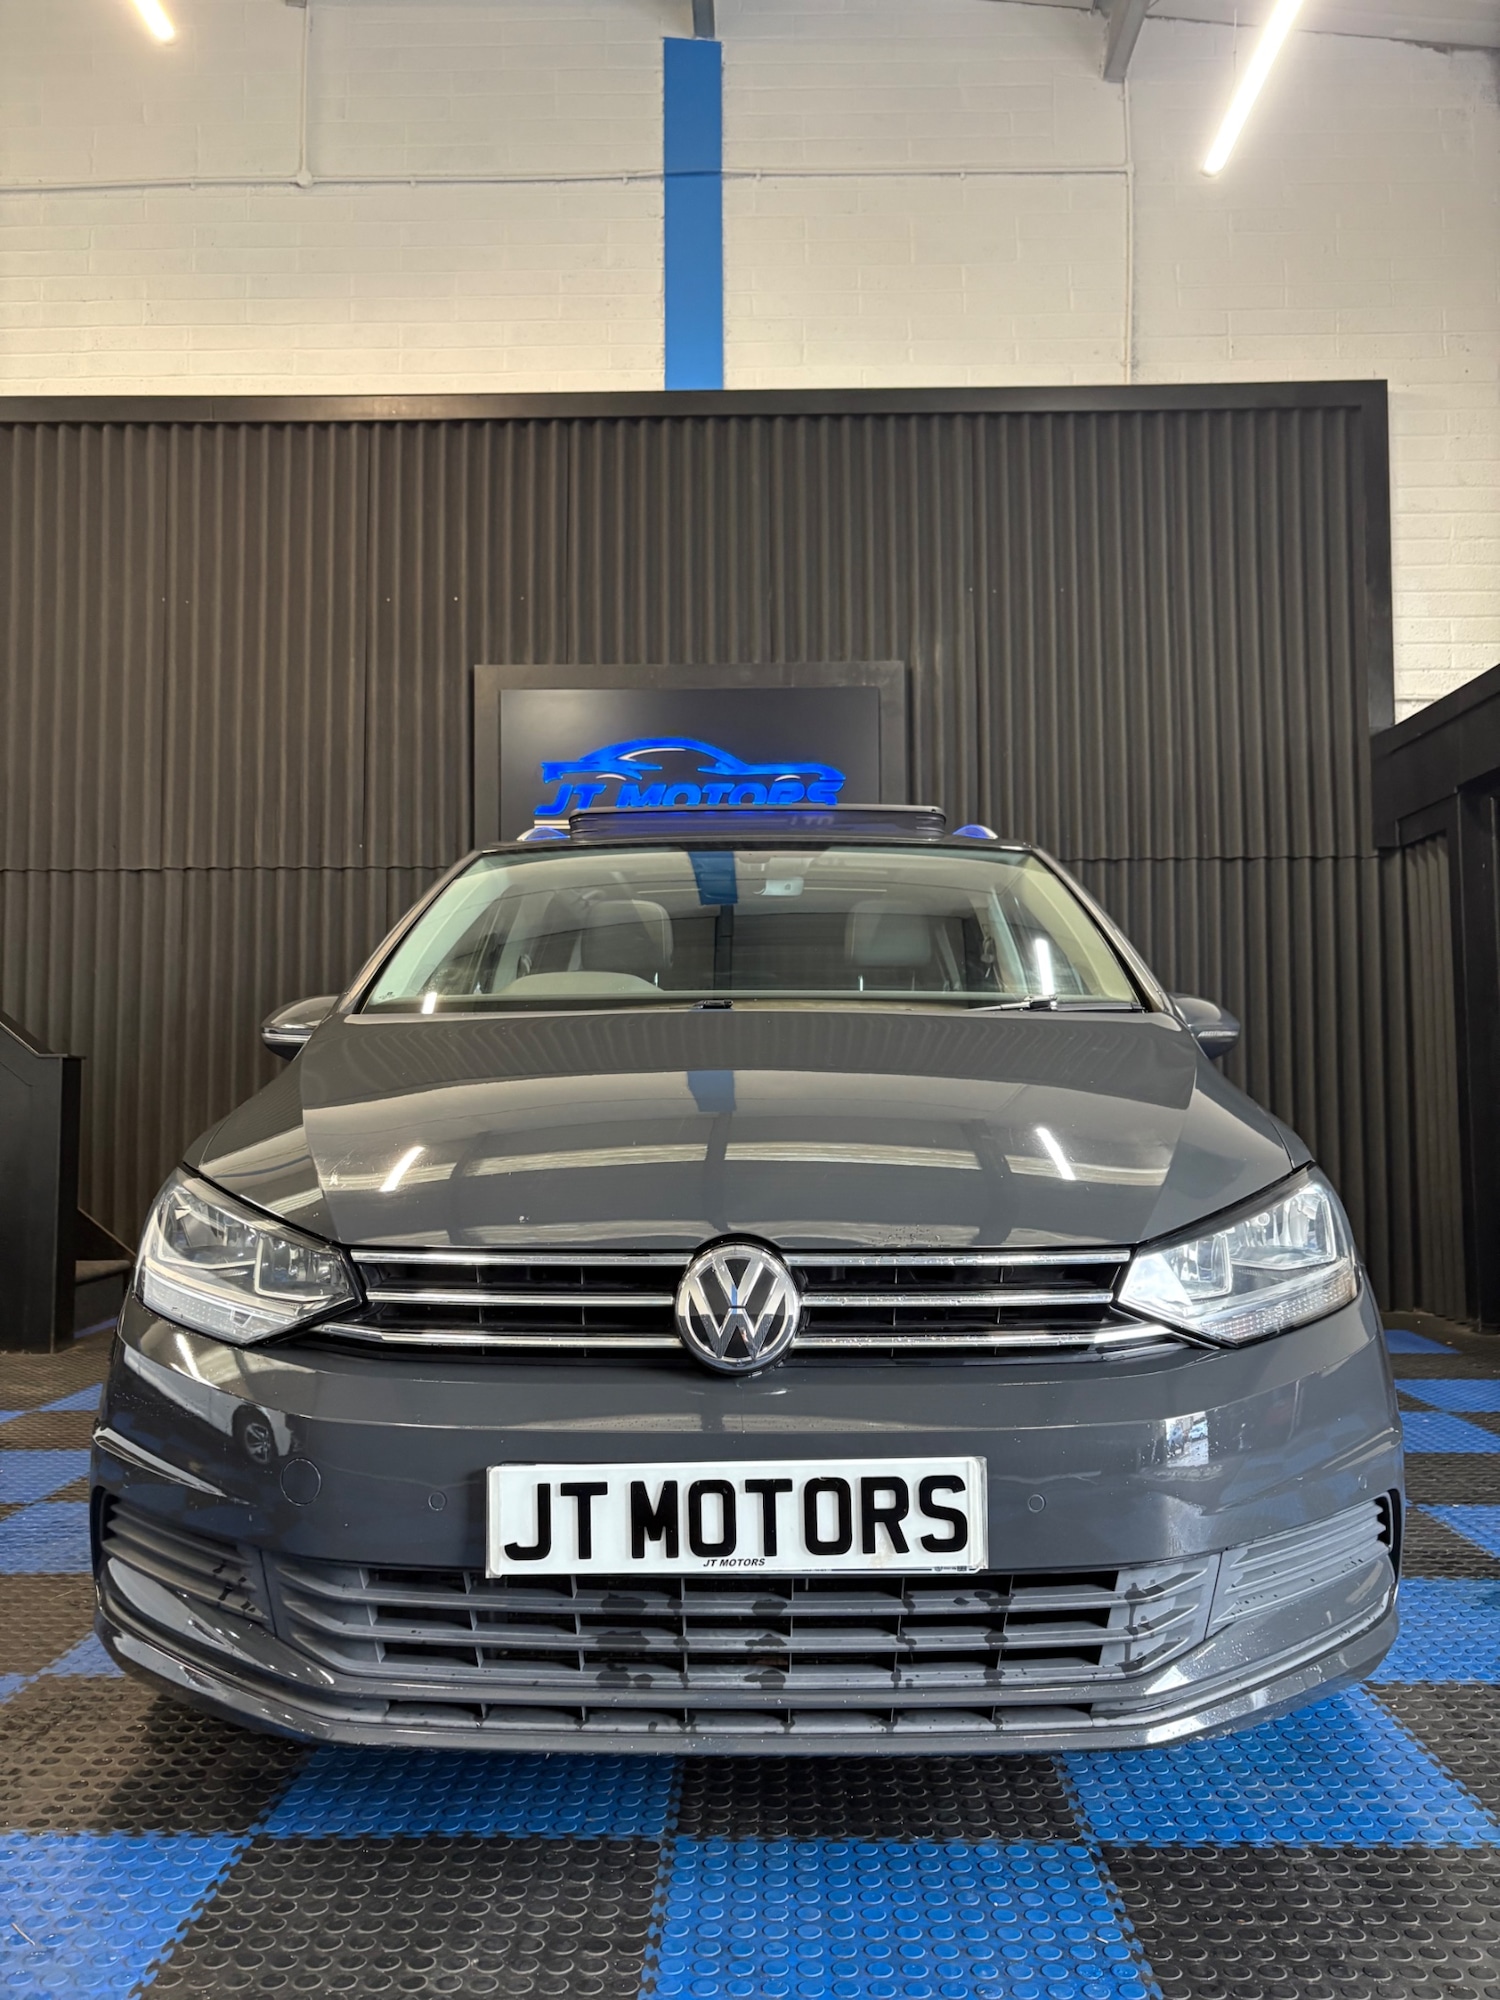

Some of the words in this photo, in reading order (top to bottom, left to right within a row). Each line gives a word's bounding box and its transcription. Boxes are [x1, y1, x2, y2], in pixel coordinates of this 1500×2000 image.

[534, 783, 607, 815] JT
[616, 782, 844, 806] MOTORS
[504, 1482, 609, 1561] JT
[630, 1475, 968, 1559] MOTORS
[703, 1559, 717, 1567] JT
[719, 1558, 766, 1567] MOTORS
